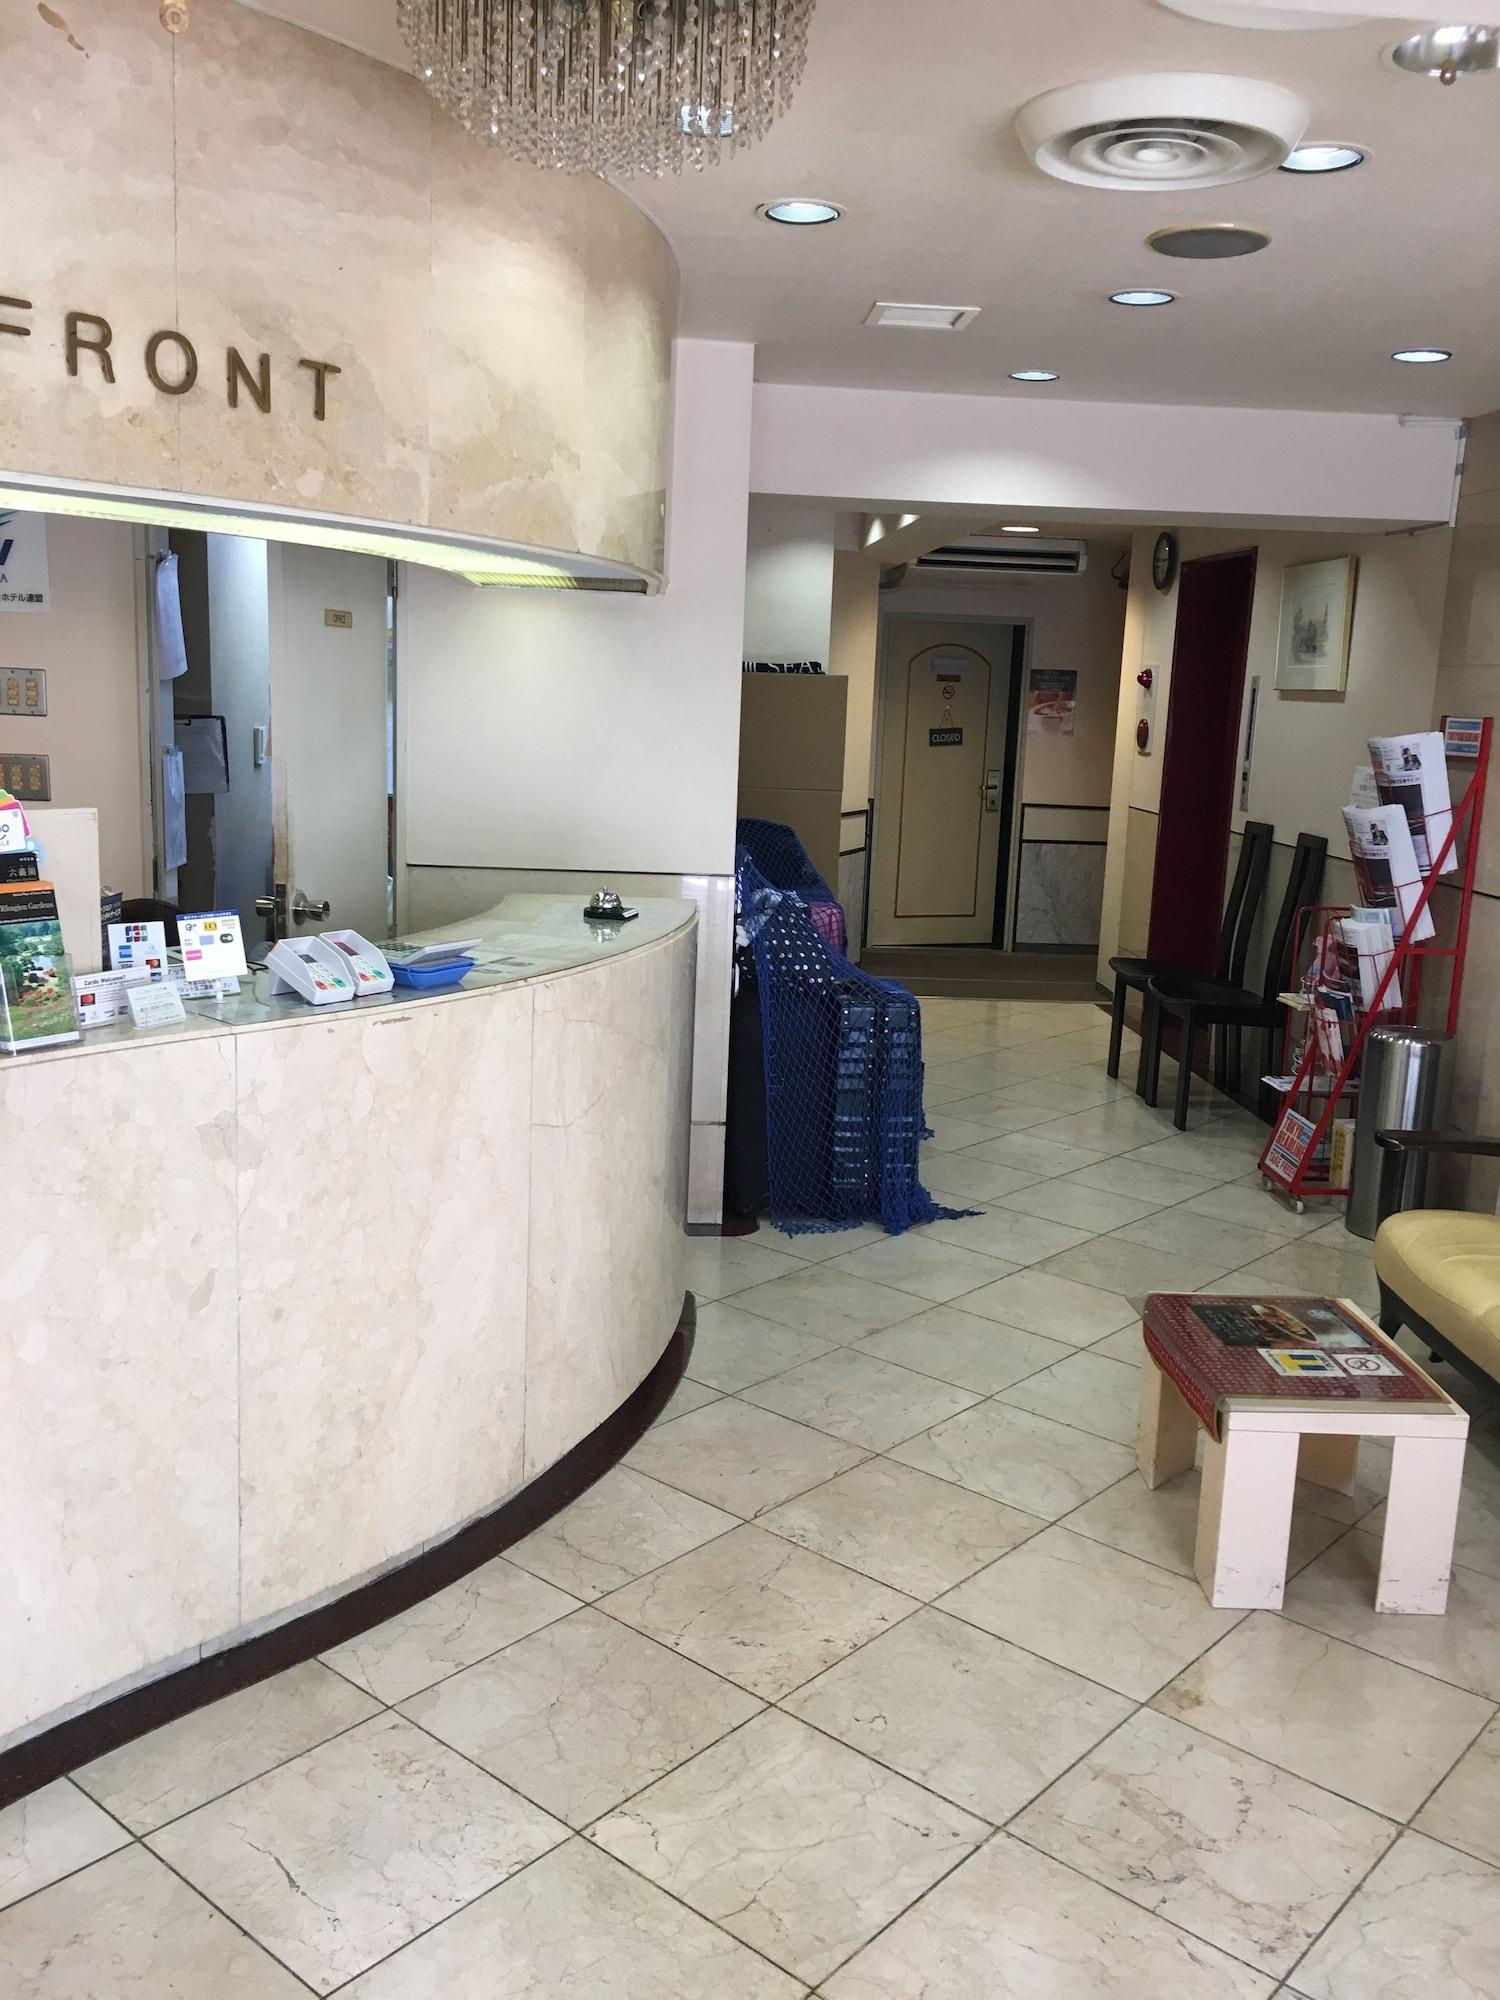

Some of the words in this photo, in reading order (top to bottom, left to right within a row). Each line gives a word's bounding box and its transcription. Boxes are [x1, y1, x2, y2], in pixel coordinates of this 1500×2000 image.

[931, 733, 961, 743] CLOSED
[27, 901, 55, 912] Gardens
[1281, 1115, 1304, 1140] TOKYO
